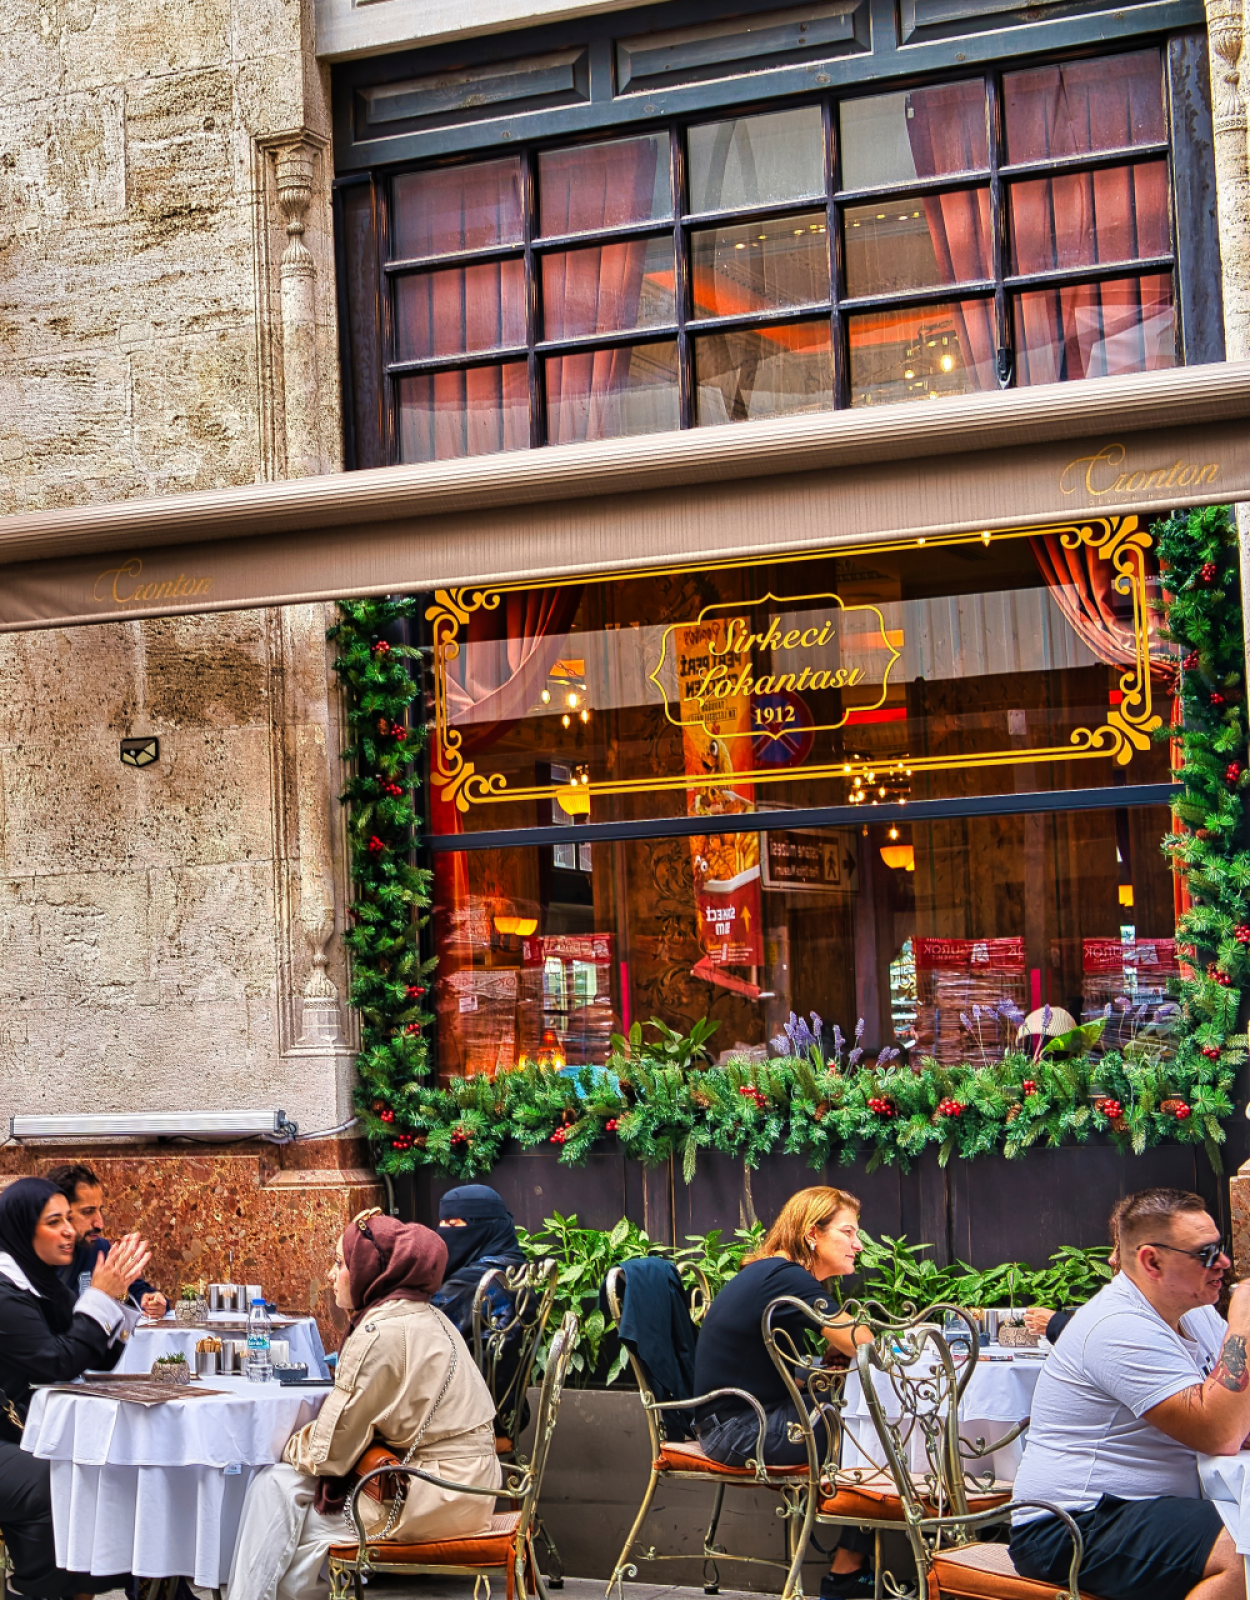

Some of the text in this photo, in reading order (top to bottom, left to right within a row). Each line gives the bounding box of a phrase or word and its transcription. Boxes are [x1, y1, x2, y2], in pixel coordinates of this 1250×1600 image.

[709, 617, 836, 656] Sirkeci
[683, 663, 866, 707] Lokantası
[754, 705, 796, 726] 1912
